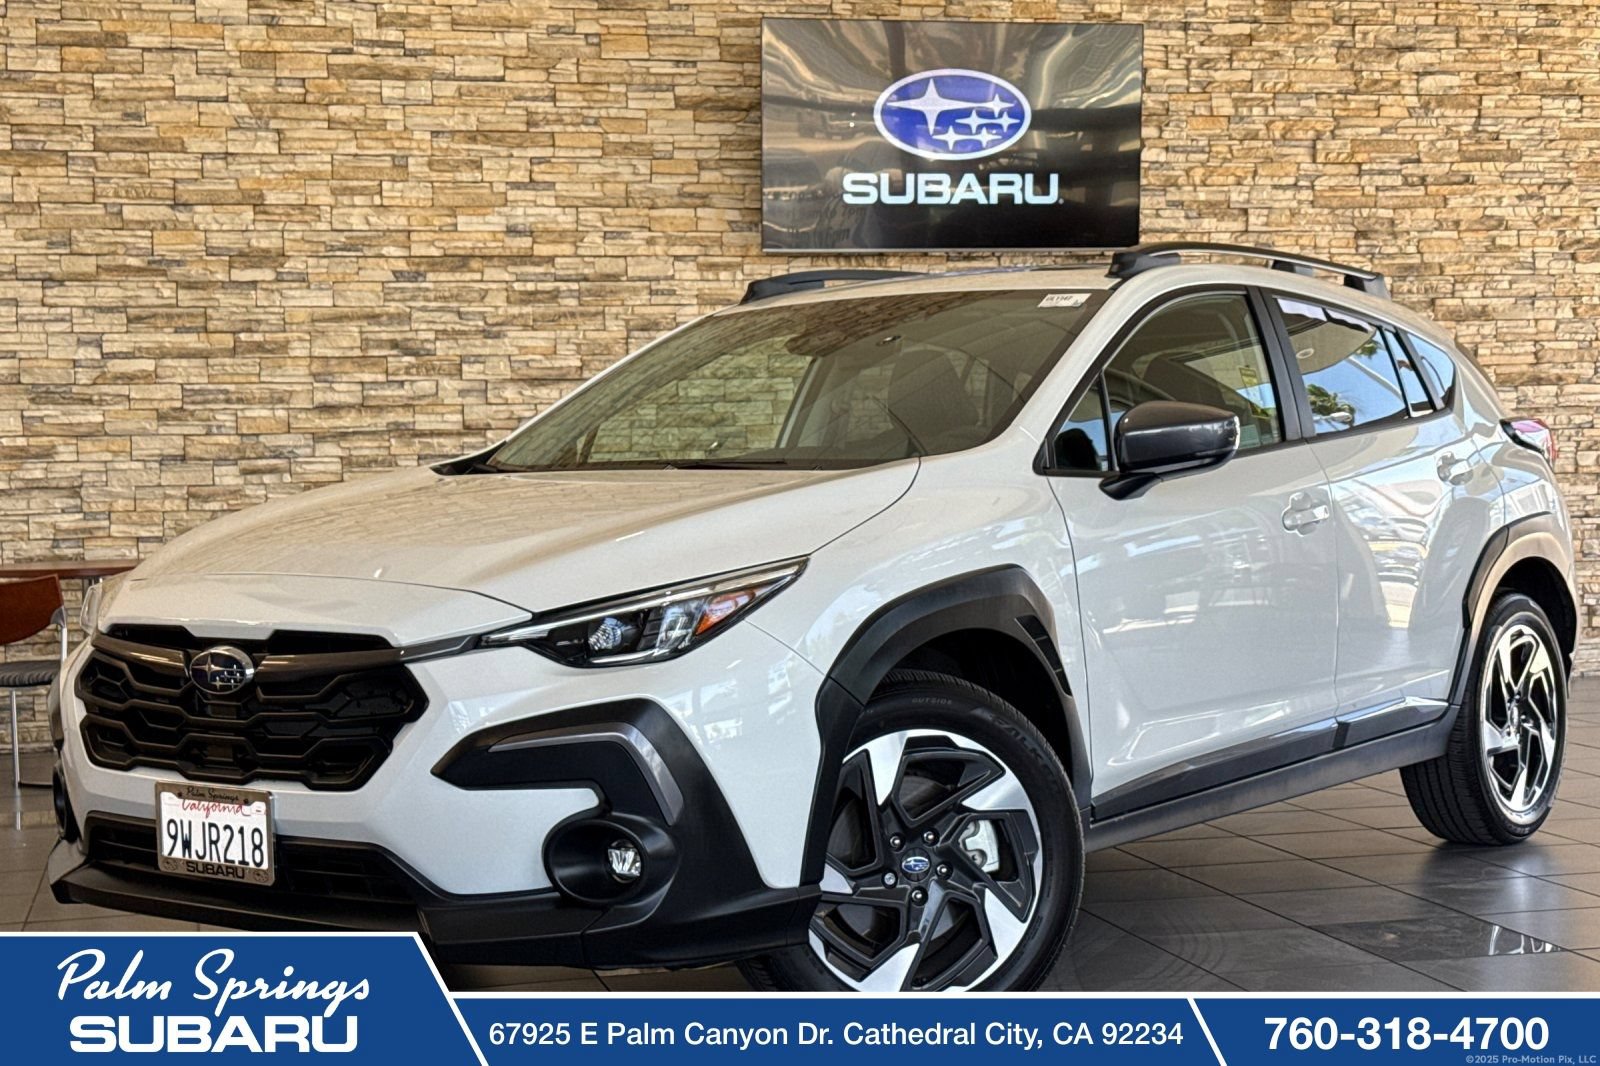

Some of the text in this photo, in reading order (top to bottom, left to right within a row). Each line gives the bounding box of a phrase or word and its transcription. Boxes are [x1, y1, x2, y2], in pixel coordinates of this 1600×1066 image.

[842, 172, 1061, 205] SUBARU
[186, 785, 239, 803] Palm Springs
[182, 798, 251, 819] California
[167, 818, 264, 868] 9WJR218
[186, 860, 245, 880] SUBARU
